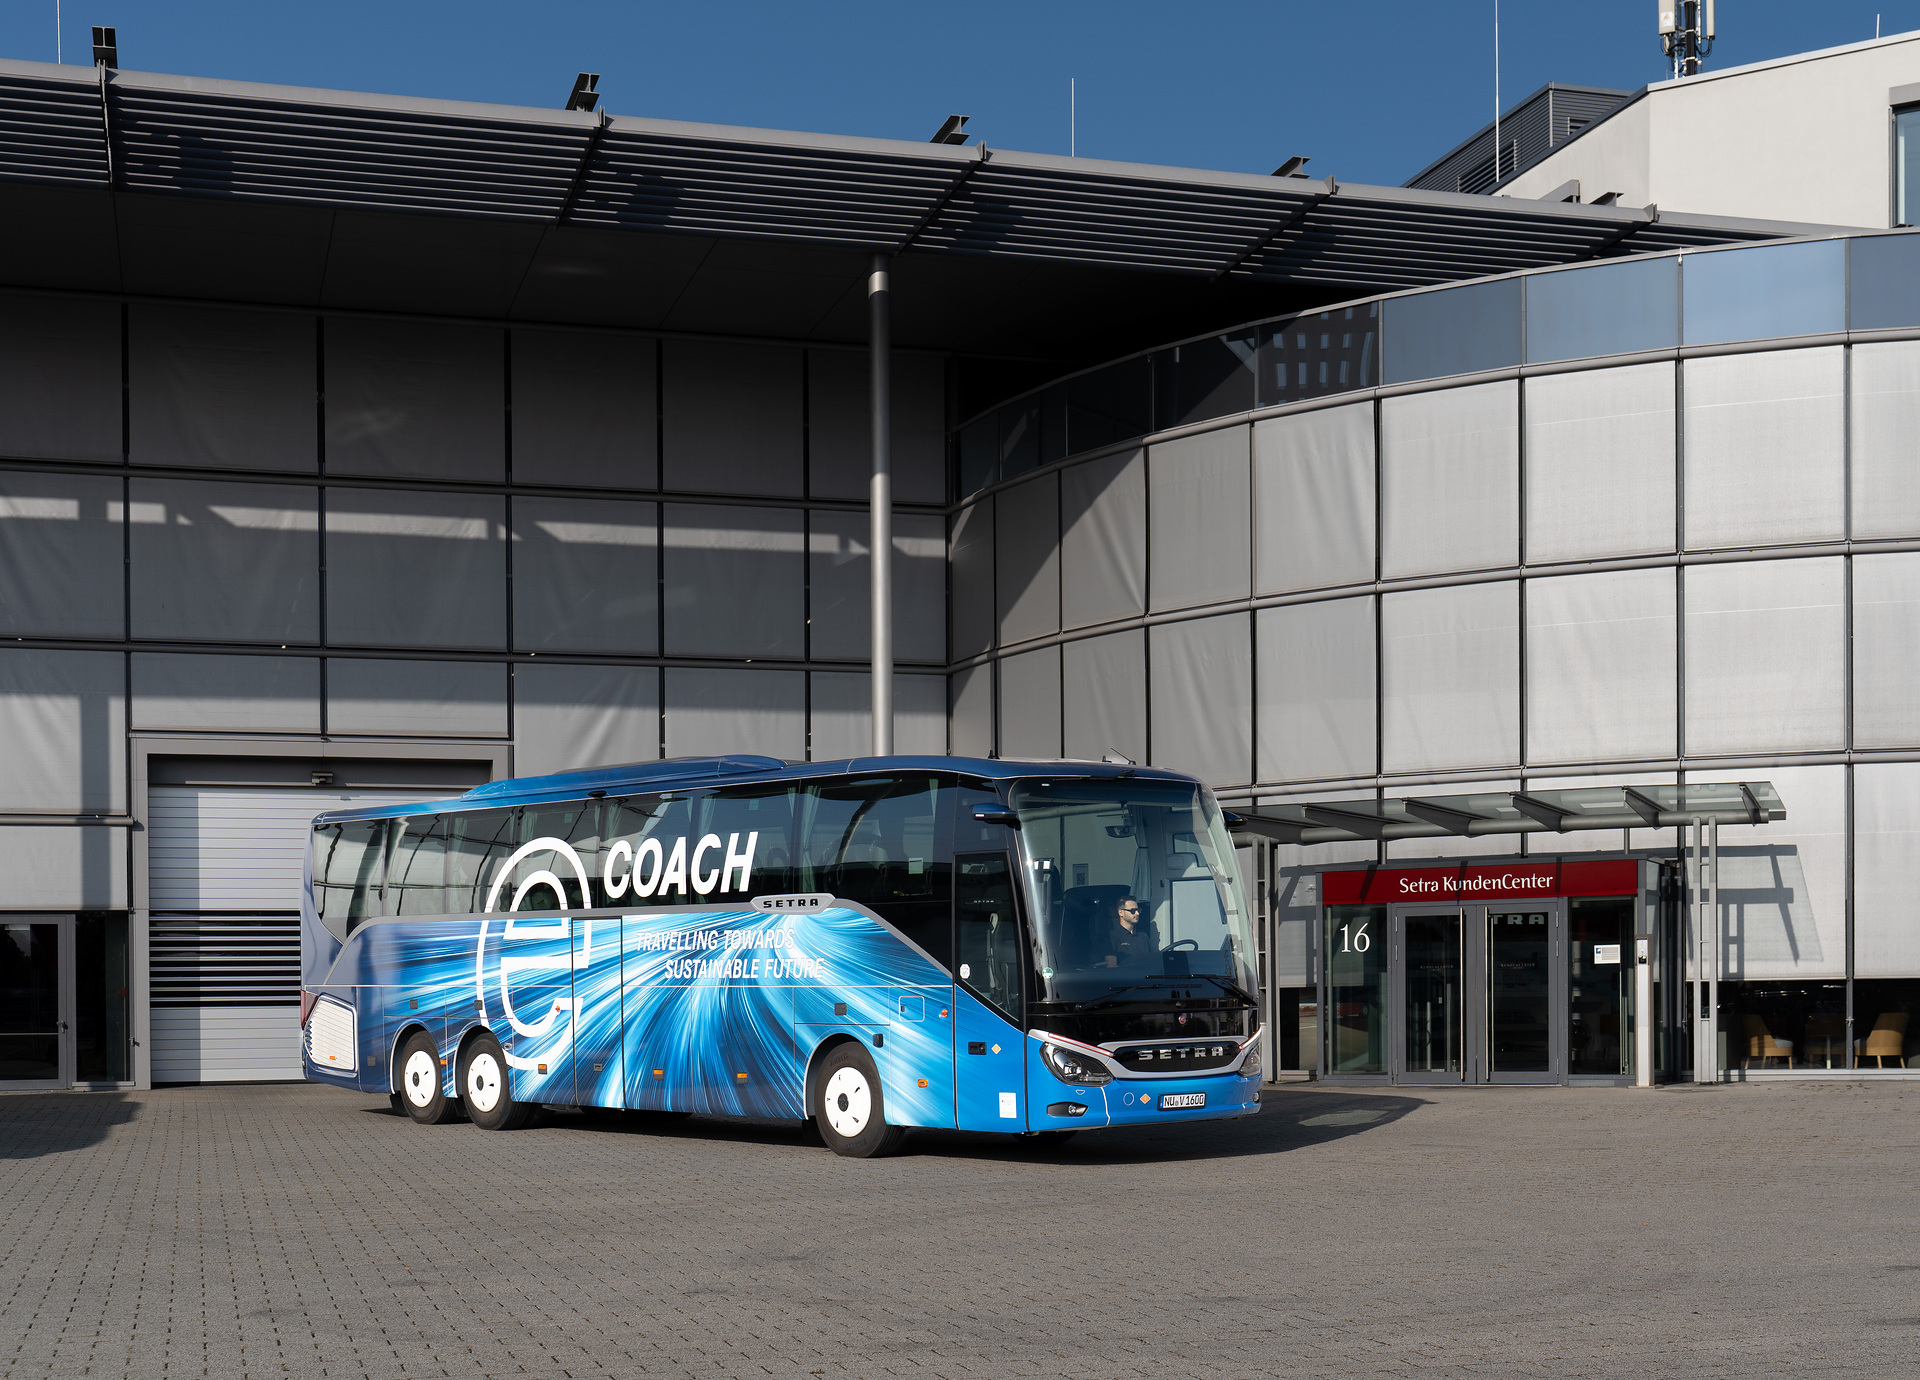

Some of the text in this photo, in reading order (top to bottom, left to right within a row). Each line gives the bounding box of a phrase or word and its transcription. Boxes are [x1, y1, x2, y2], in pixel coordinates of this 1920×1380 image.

[603, 831, 759, 899] COACH
[1399, 873, 1553, 893] Setra KundenCenter
[763, 898, 819, 908] SETRA
[1488, 914, 1545, 925] TRA
[636, 928, 796, 951] TRAVELLING TOWARDS
[1340, 922, 1370, 953] 16
[665, 957, 825, 979] SUSTAINABLE FUTURE
[1138, 1046, 1224, 1060] SETRA
